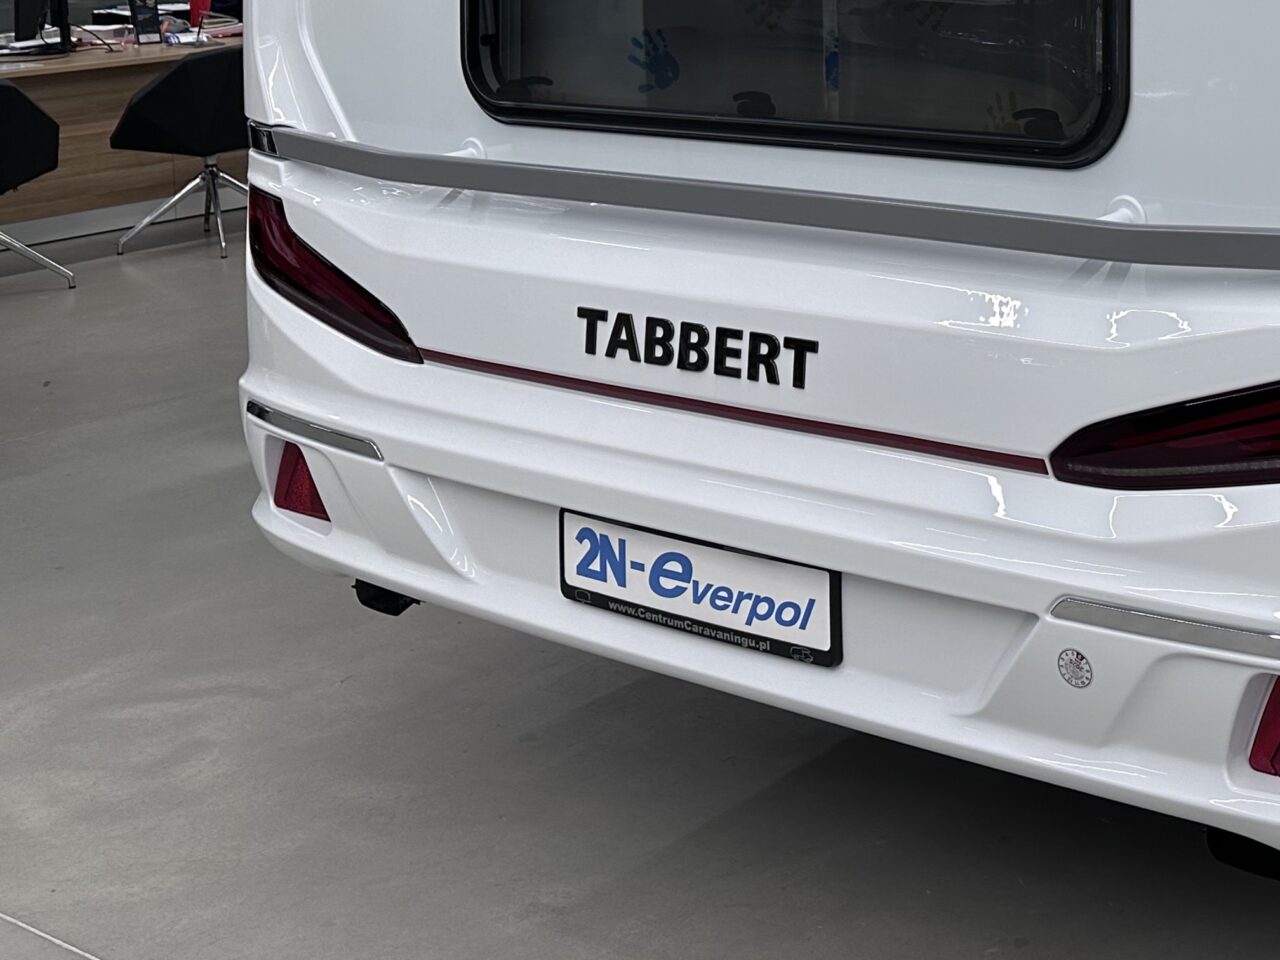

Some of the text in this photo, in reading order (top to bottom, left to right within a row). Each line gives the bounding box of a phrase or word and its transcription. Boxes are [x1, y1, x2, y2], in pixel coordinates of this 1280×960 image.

[577, 306, 819, 390] TABBERT
[575, 526, 817, 631] 2N-everpol
[608, 600, 771, 652] www.CentrumCaravaningu.pl
